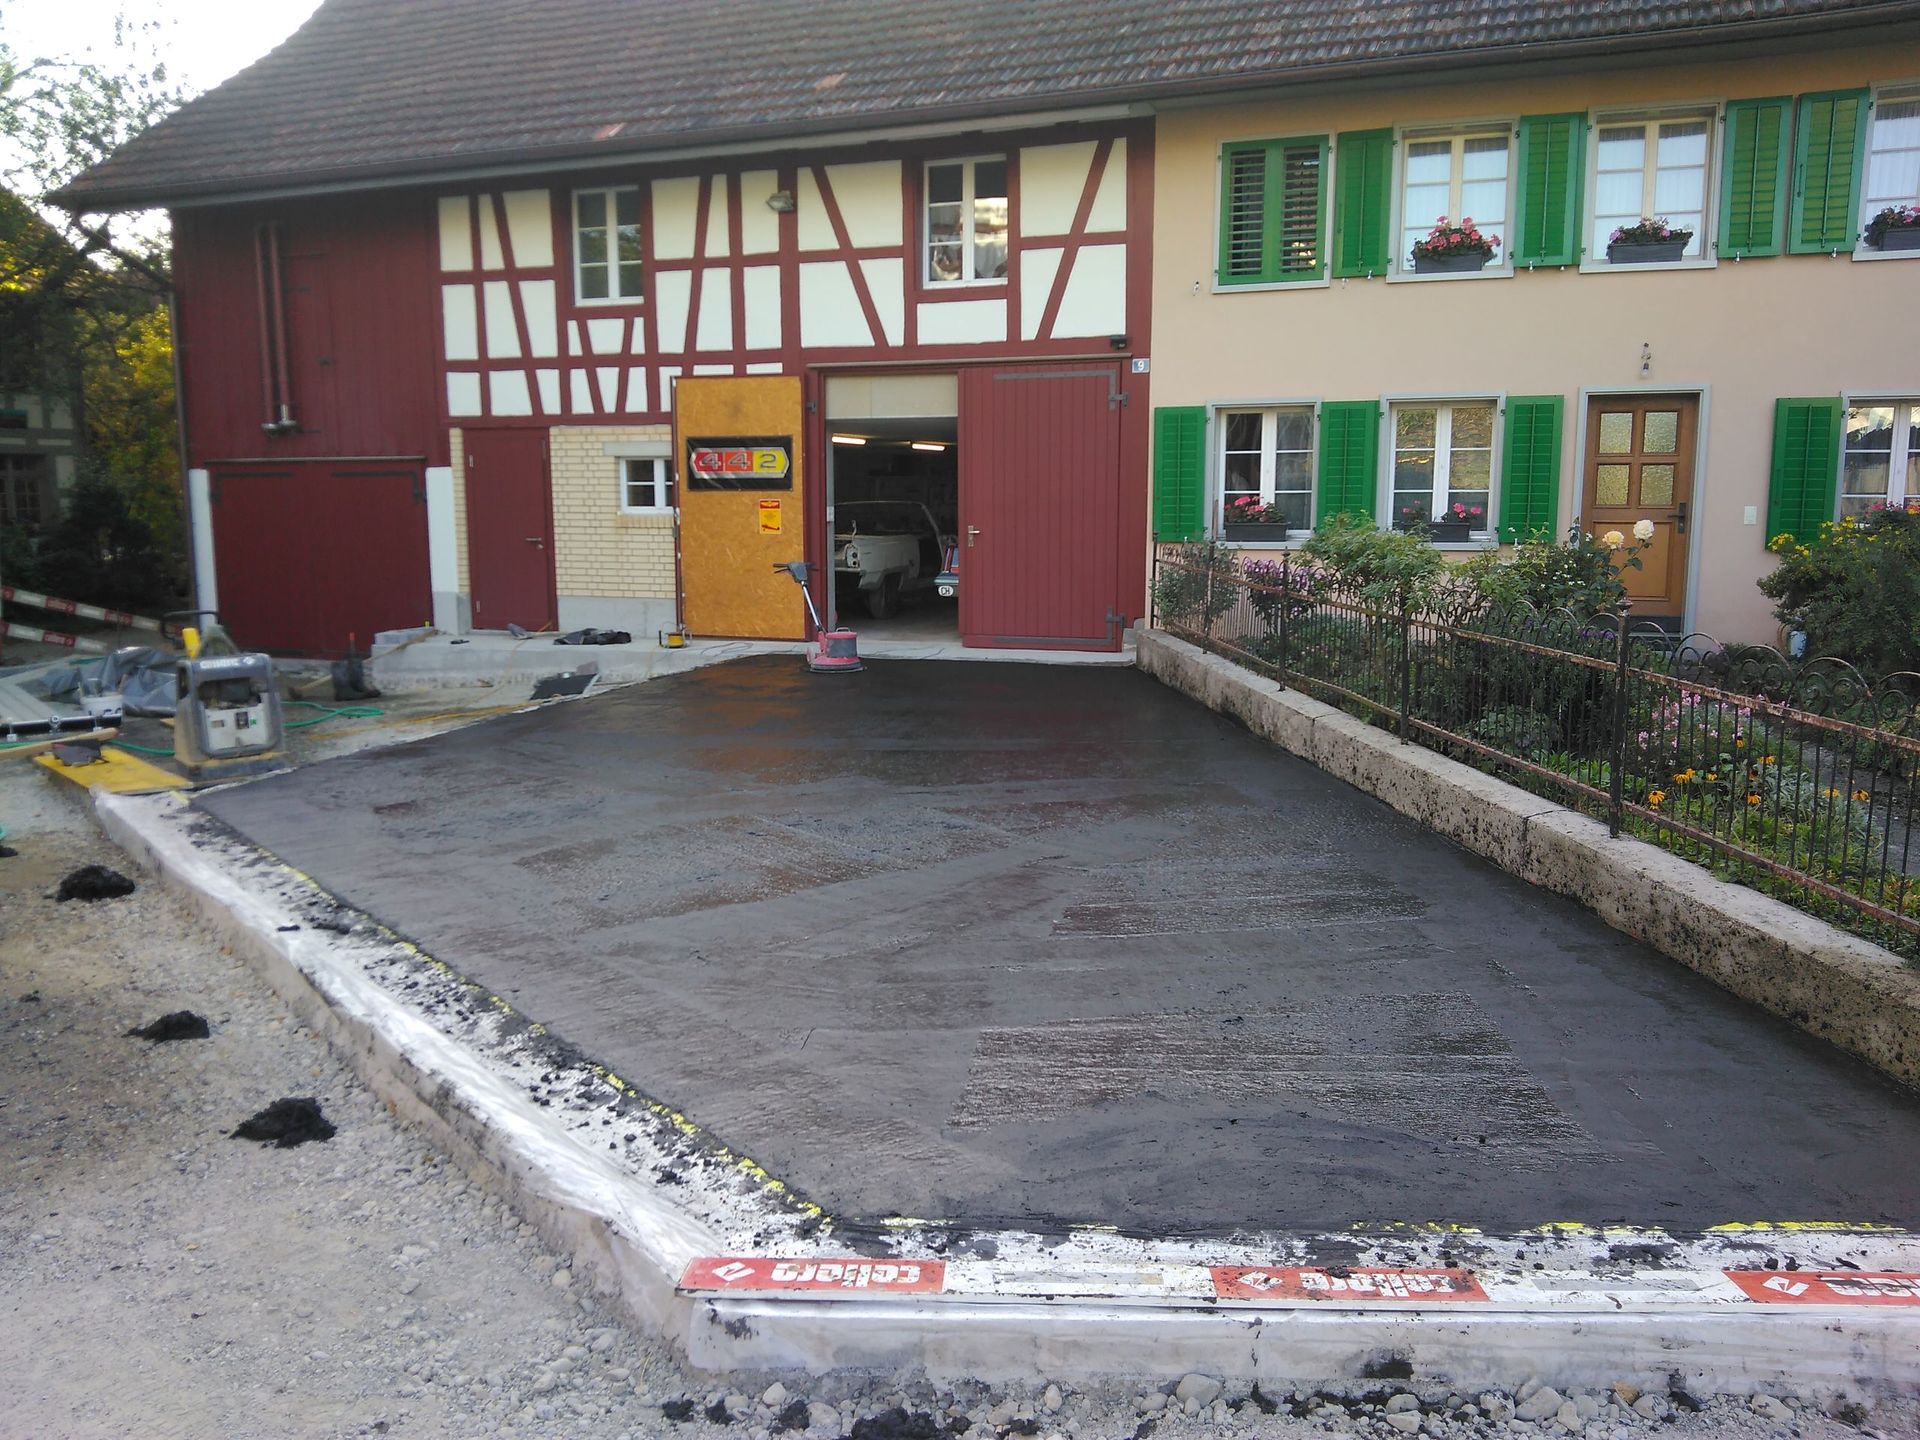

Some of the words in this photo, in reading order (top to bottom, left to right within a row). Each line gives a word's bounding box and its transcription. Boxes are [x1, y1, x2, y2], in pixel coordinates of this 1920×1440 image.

[1137, 360, 1145, 371] 9
[940, 586, 951, 596] CH
[771, 1262, 921, 1288] cellere
